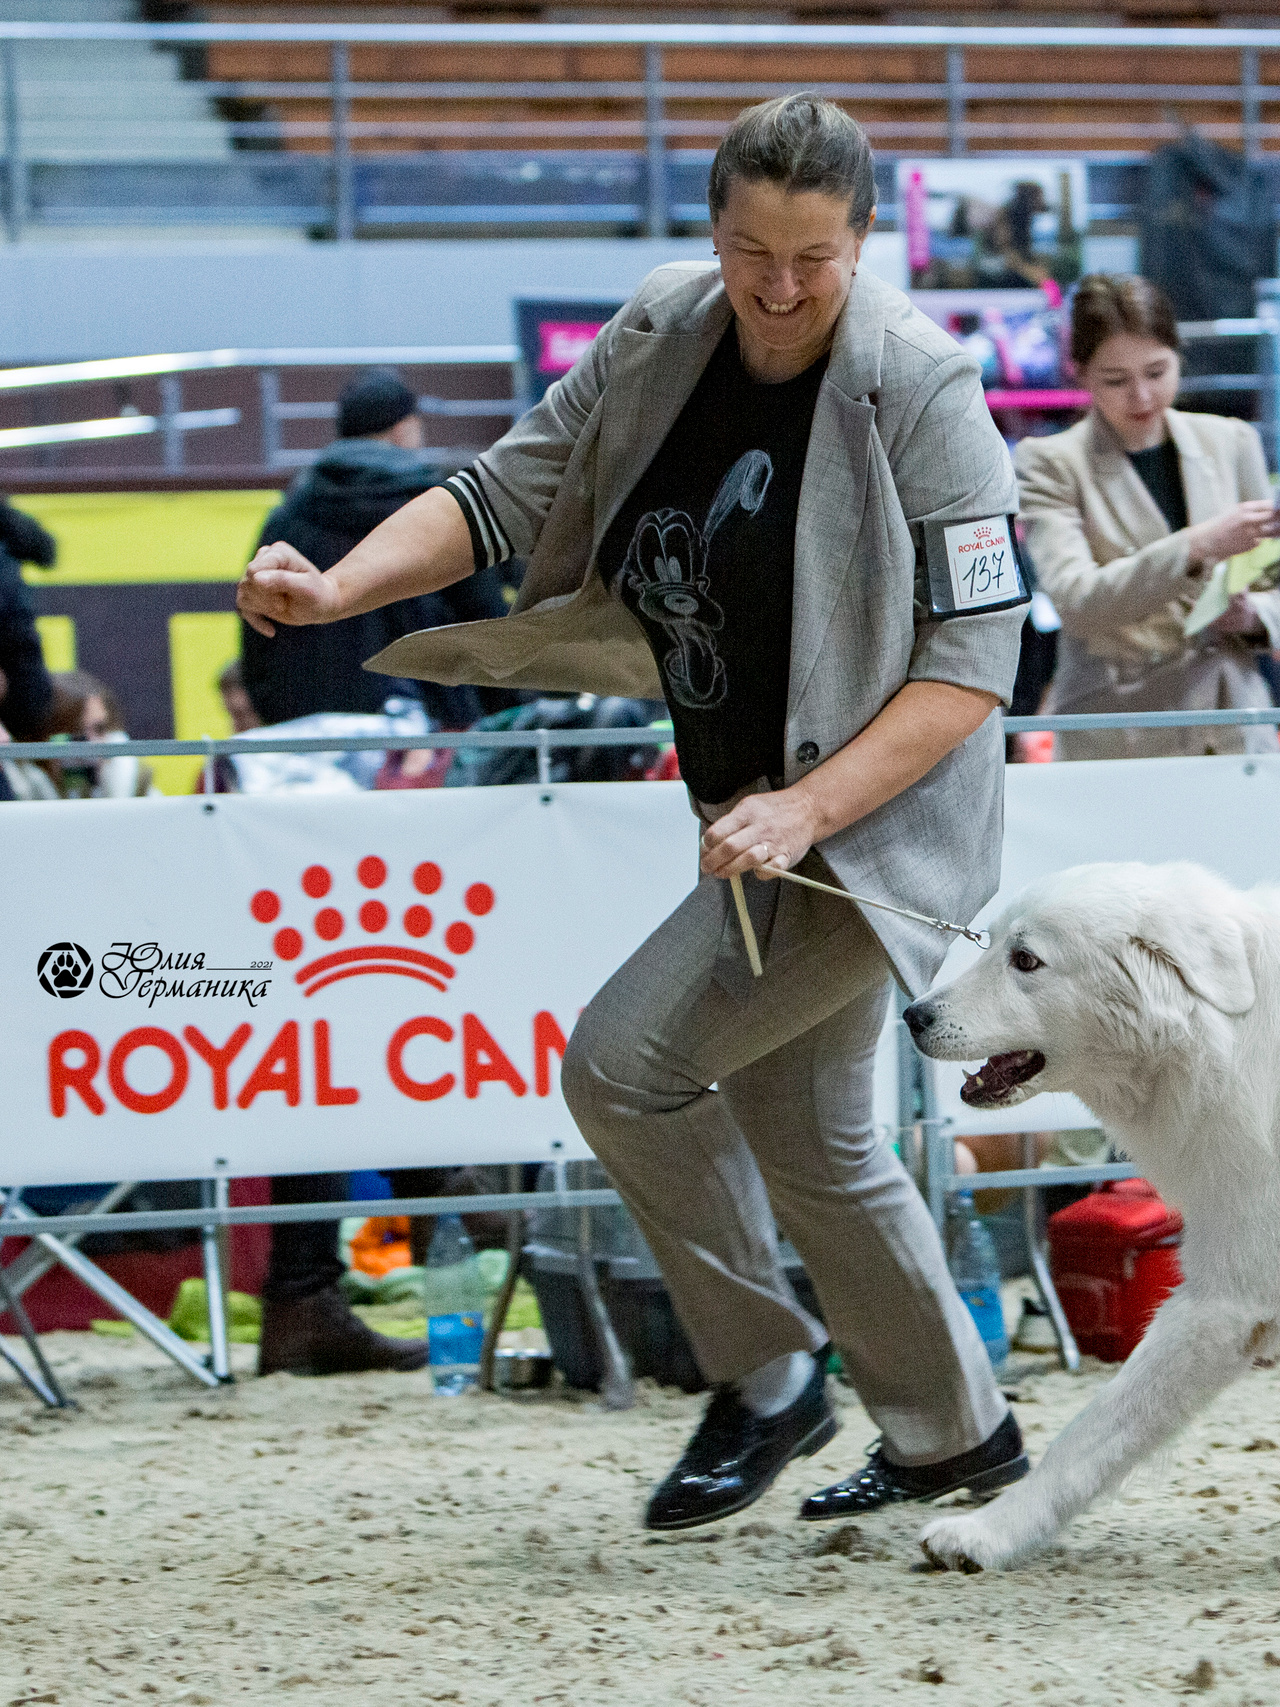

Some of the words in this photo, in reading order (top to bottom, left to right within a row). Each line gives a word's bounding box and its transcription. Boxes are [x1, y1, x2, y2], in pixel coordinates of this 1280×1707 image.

[958, 542, 984, 554] ROYAL
[962, 550, 1005, 598] 137
[48, 1018, 360, 1118] ROYAL
